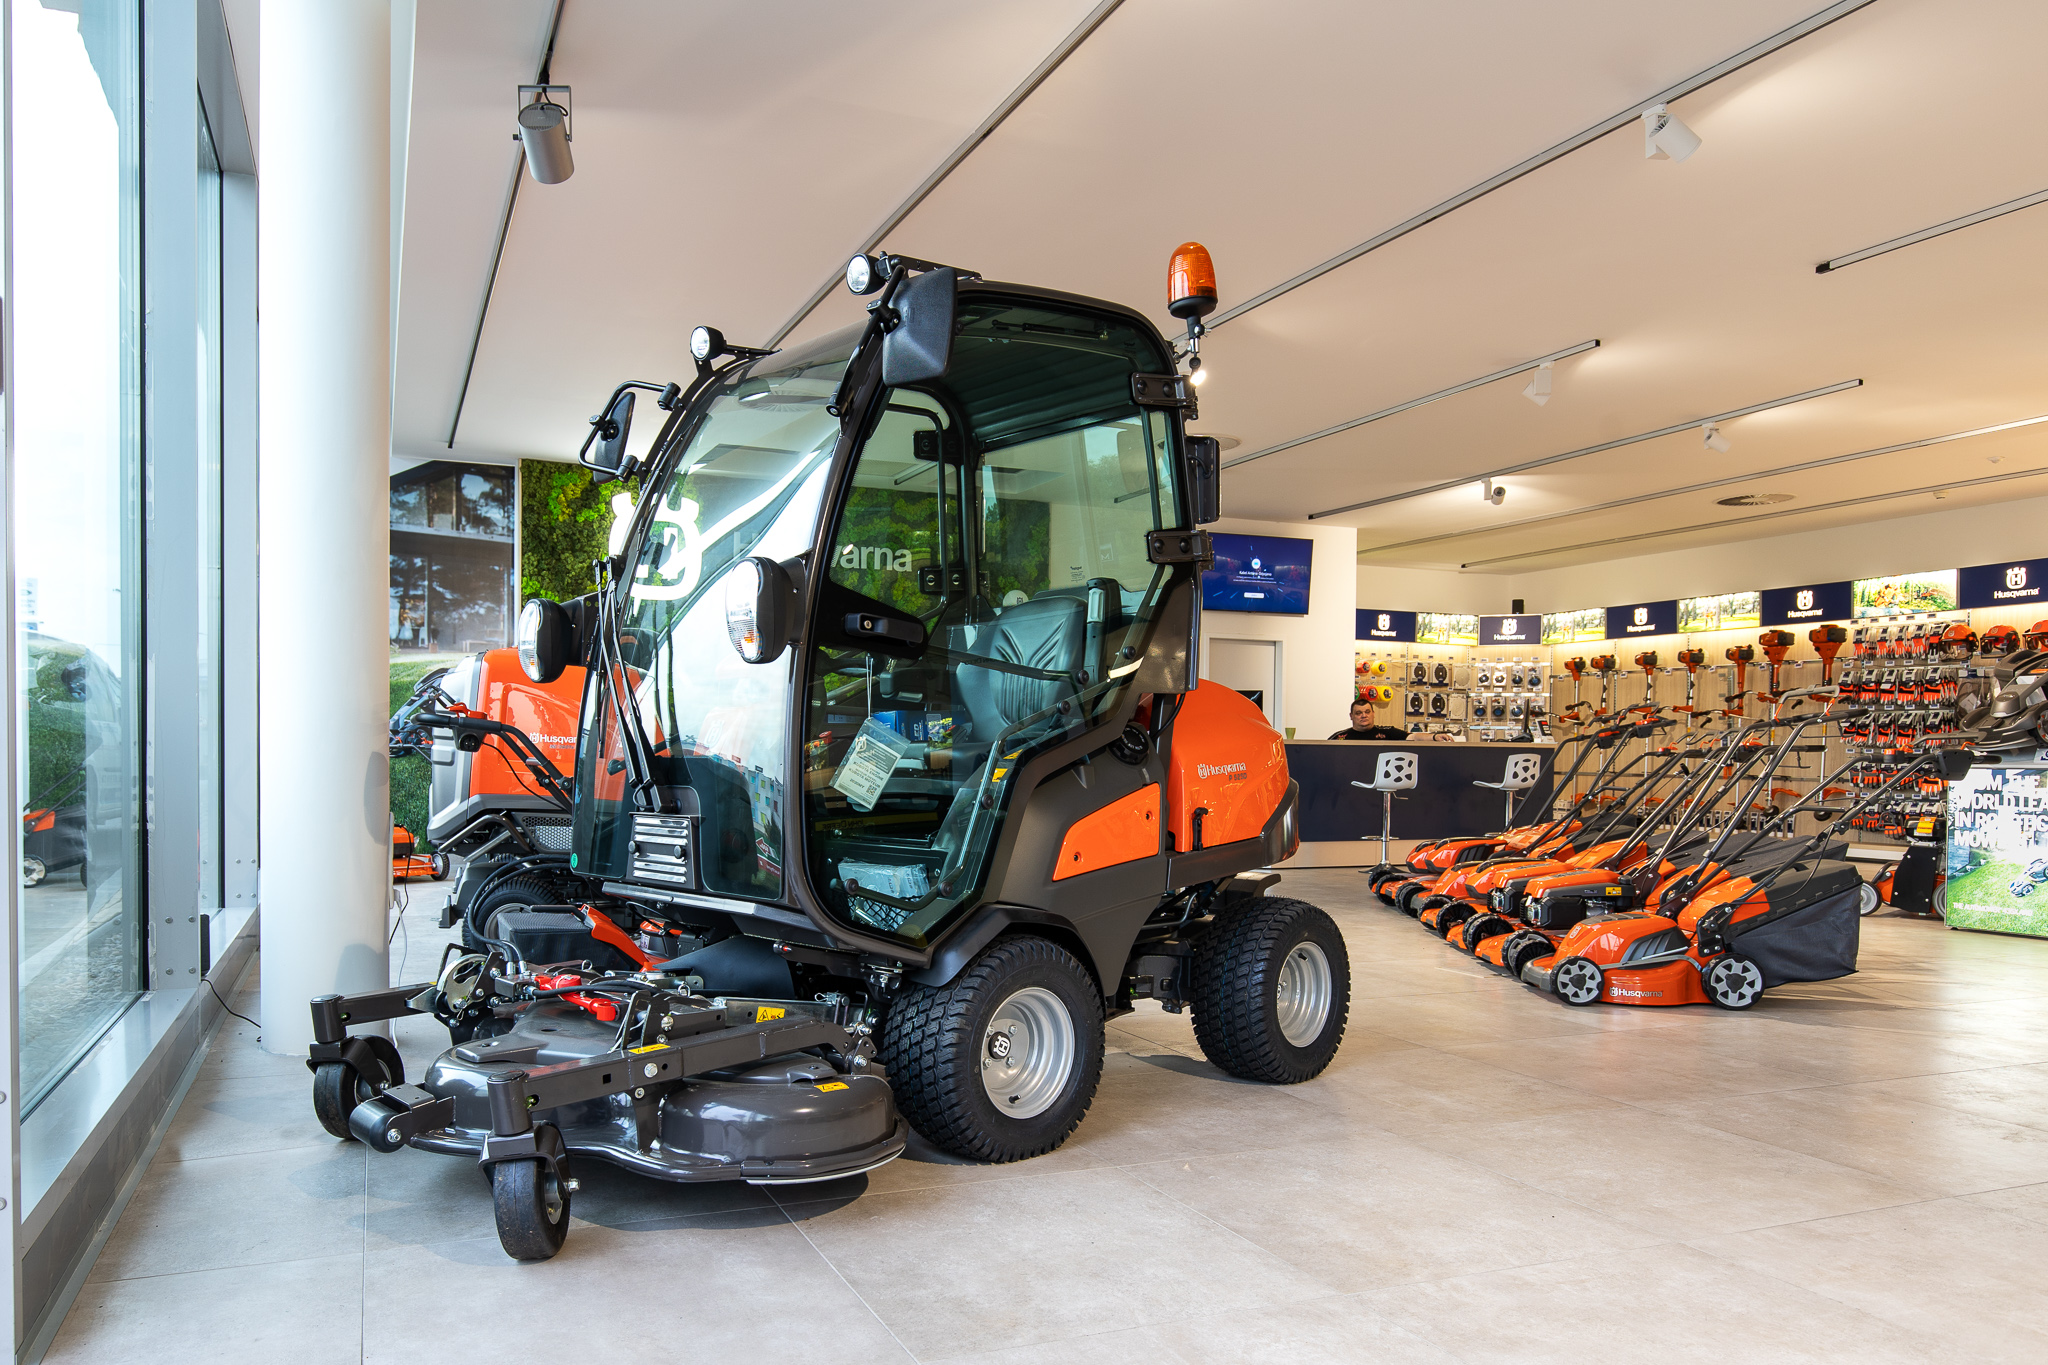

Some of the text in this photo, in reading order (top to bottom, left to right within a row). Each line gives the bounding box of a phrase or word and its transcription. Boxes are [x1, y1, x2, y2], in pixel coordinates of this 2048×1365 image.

[1993, 587, 2040, 599] Husqvarna
[1787, 608, 1823, 619] Husqvarna
[540, 733, 577, 744] Husqvar
[1206, 762, 1247, 776] Husqvarna
[1954, 811, 1971, 828] IN
[1618, 988, 1663, 998] Husqvarna
